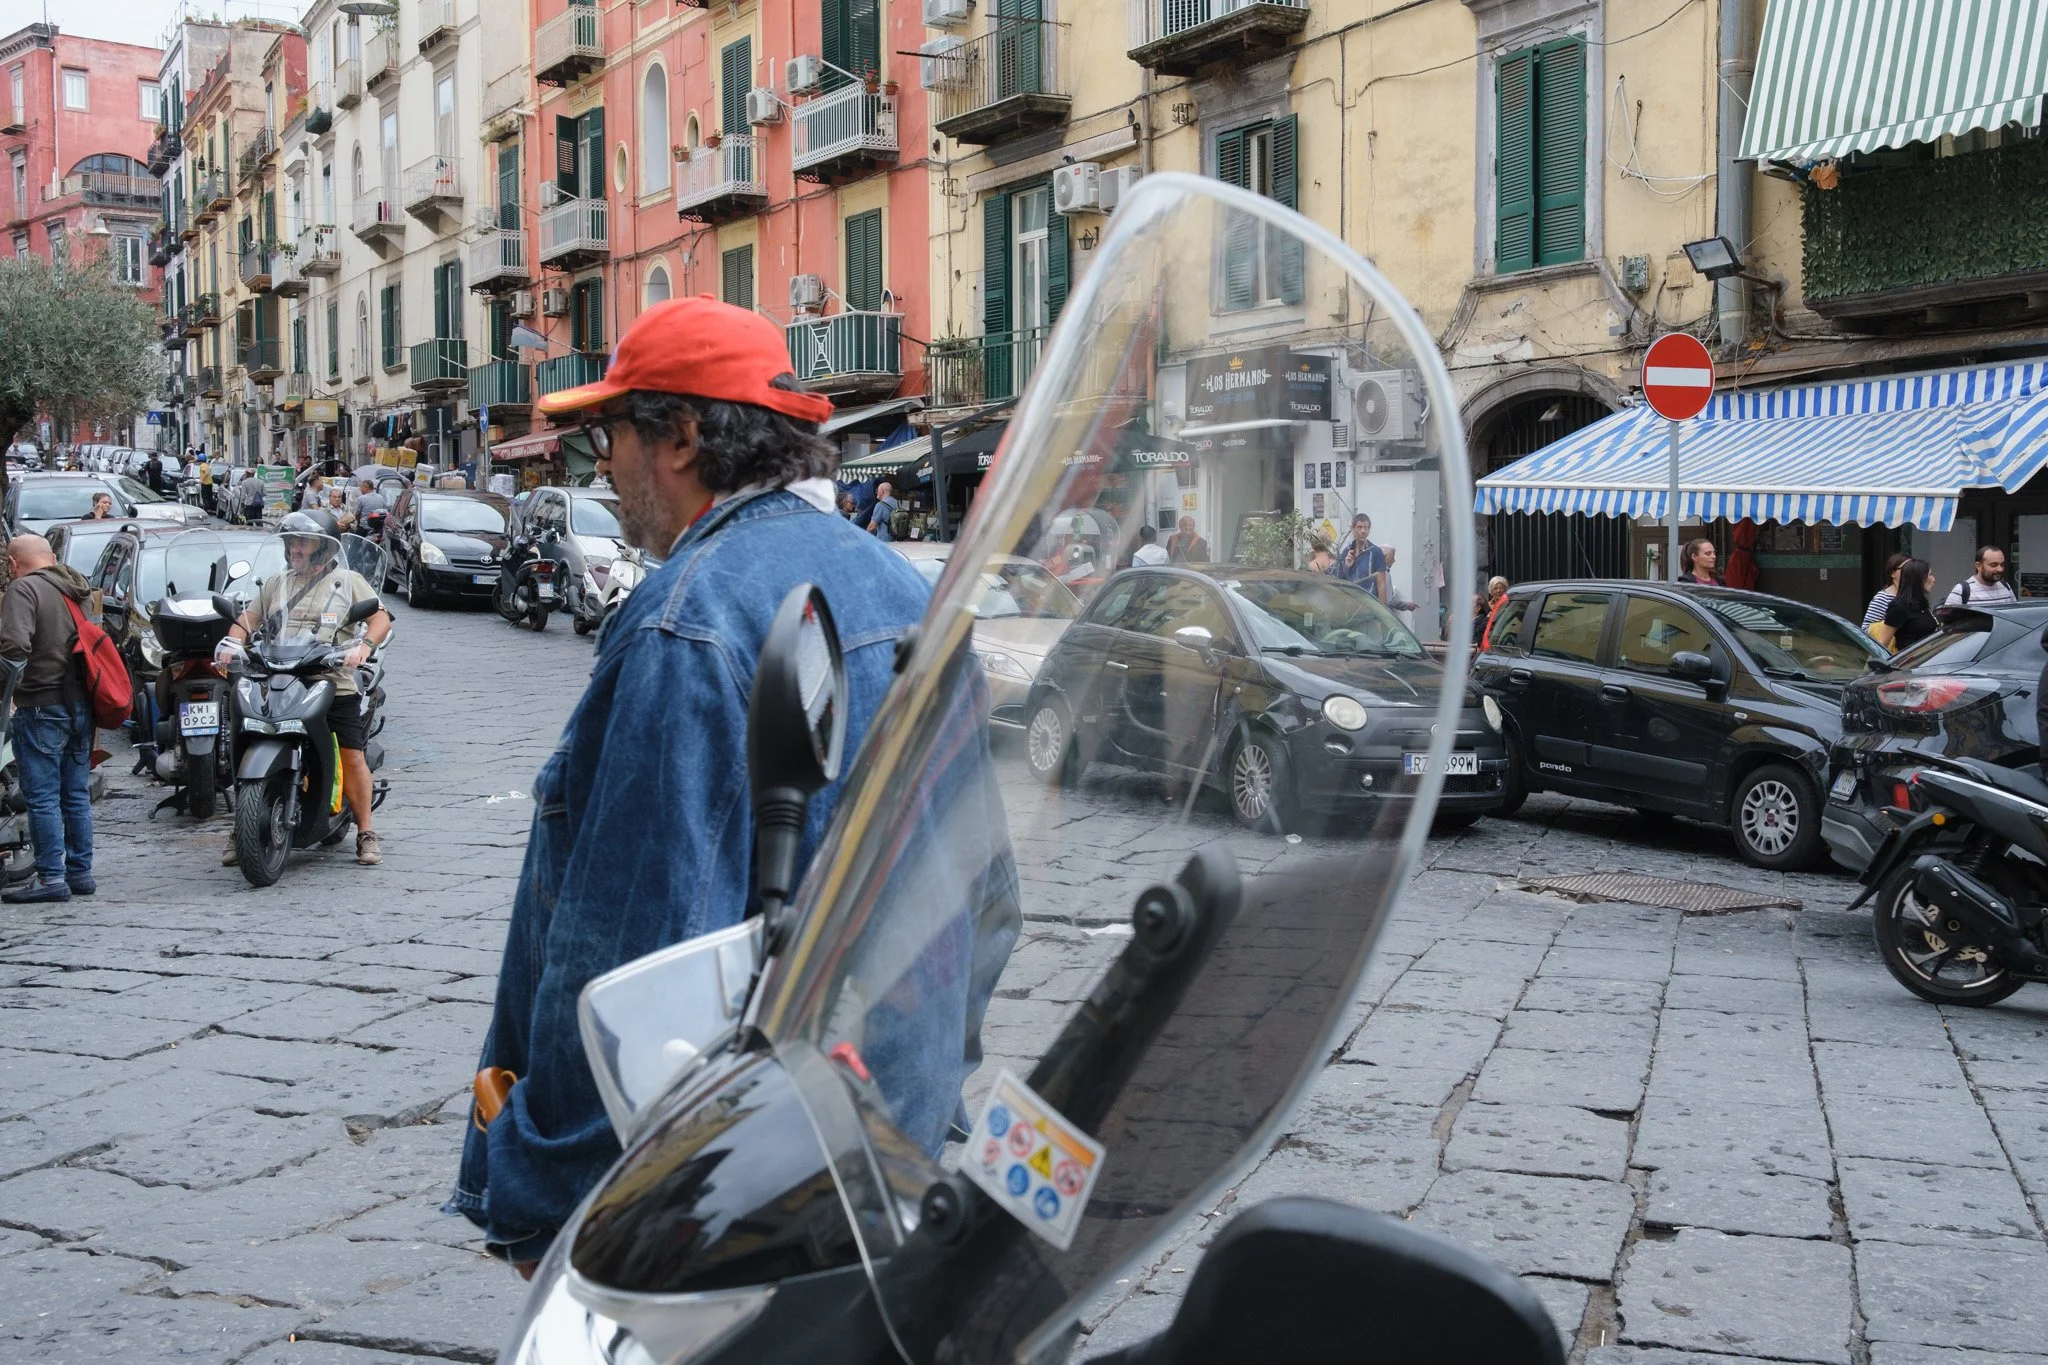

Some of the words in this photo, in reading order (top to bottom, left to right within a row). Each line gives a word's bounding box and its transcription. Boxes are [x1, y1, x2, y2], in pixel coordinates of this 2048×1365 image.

[1206, 374, 1223, 392] LOS
[1225, 369, 1268, 391] HERMANOS
[1285, 371, 1297, 382] LOS
[1297, 371, 1326, 383] HERMANOS
[1189, 404, 1214, 414] TORALDO
[1290, 403, 1322, 412] TORALDO
[977, 454, 994, 466] TORA
[1132, 452, 1189, 463] TORALDO
[184, 715, 216, 727] 09C2
[1539, 761, 1572, 773] panda
